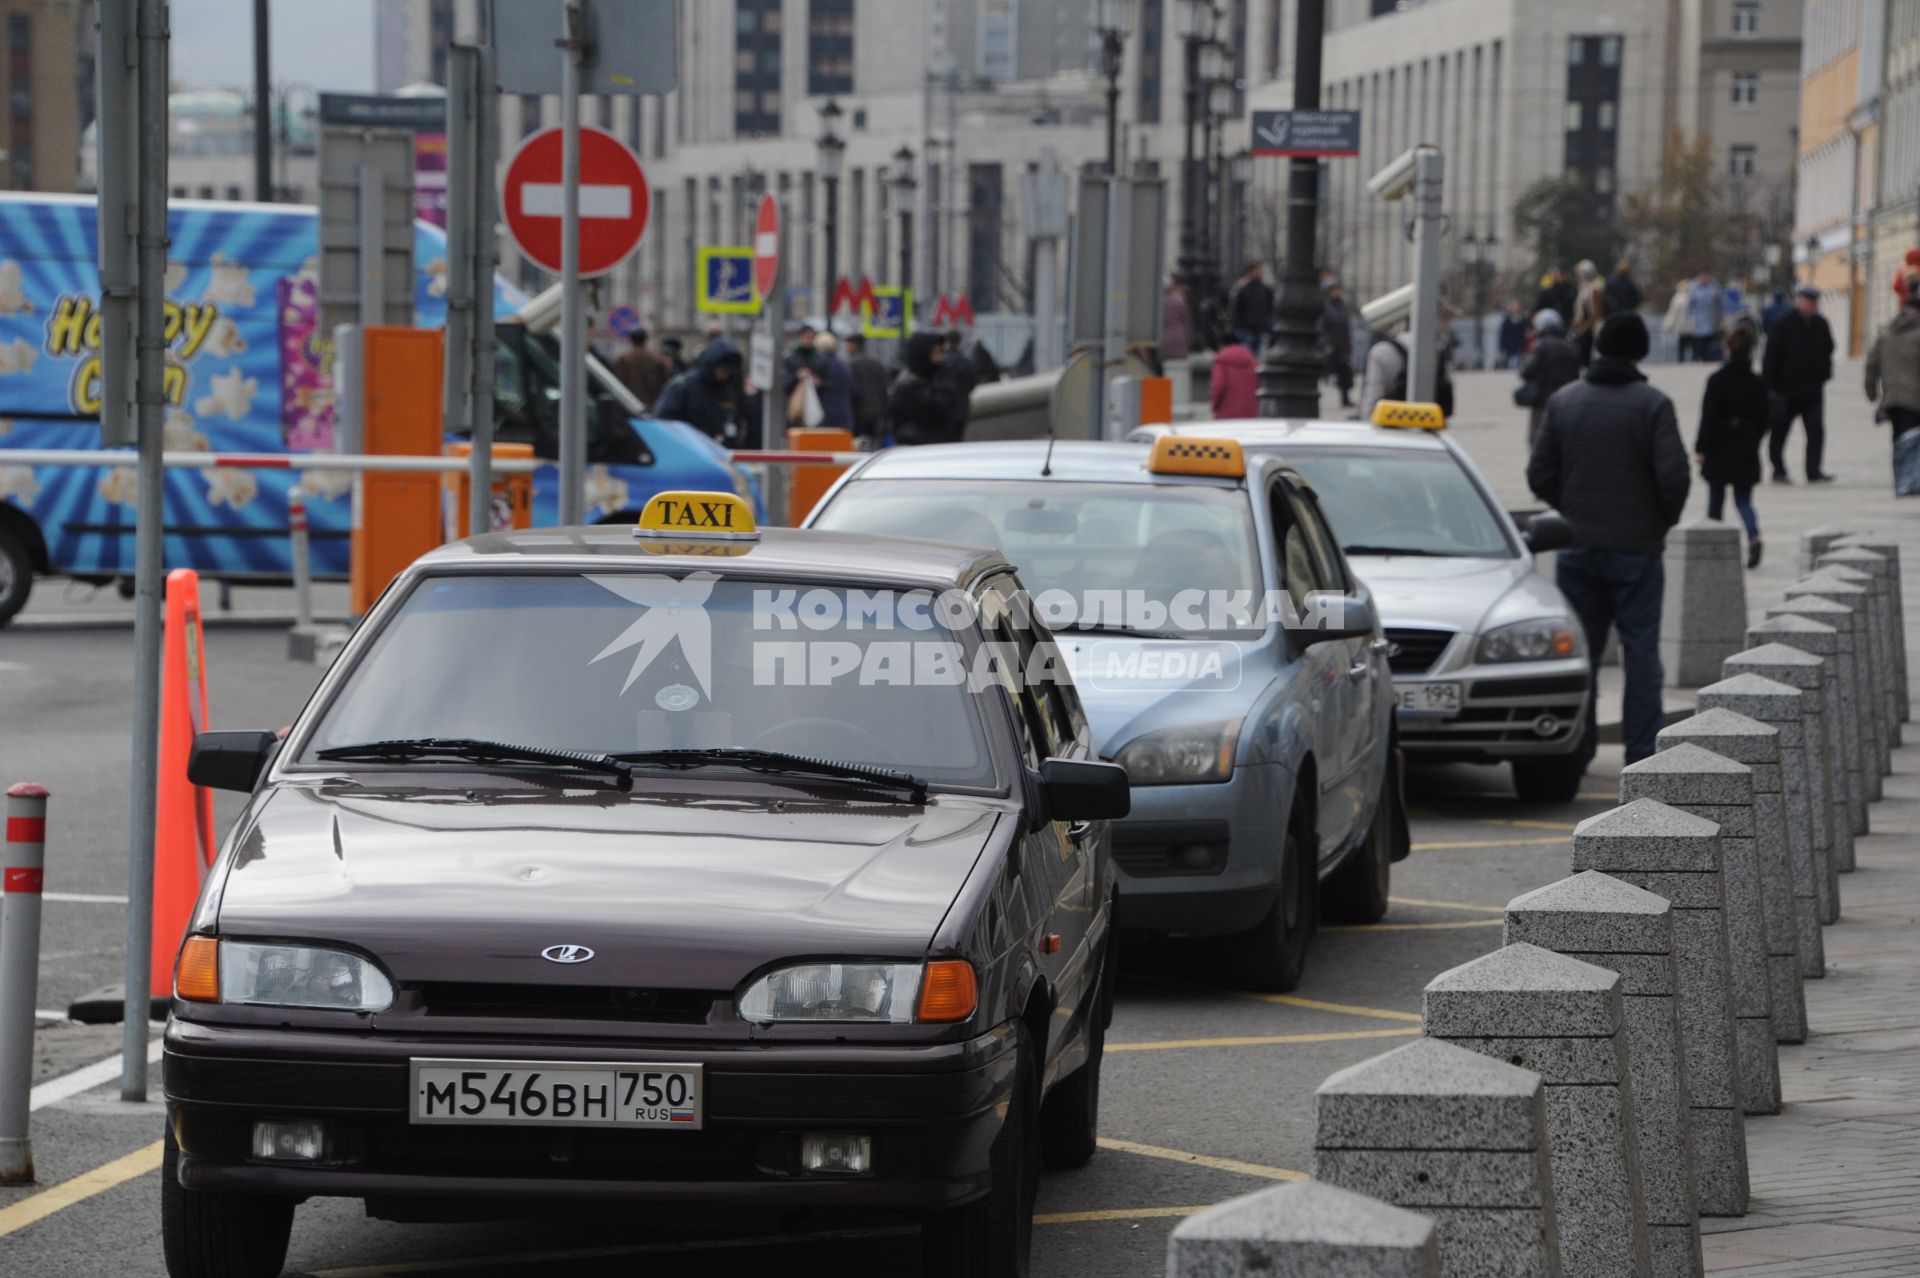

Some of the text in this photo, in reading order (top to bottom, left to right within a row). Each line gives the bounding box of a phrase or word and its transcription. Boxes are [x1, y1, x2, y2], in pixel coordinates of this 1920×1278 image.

[74, 356, 186, 414] Cn
[657, 501, 734, 527] TAXI
[426, 1072, 687, 1118] М546ВН 750
[635, 1108, 669, 1120] RUS
